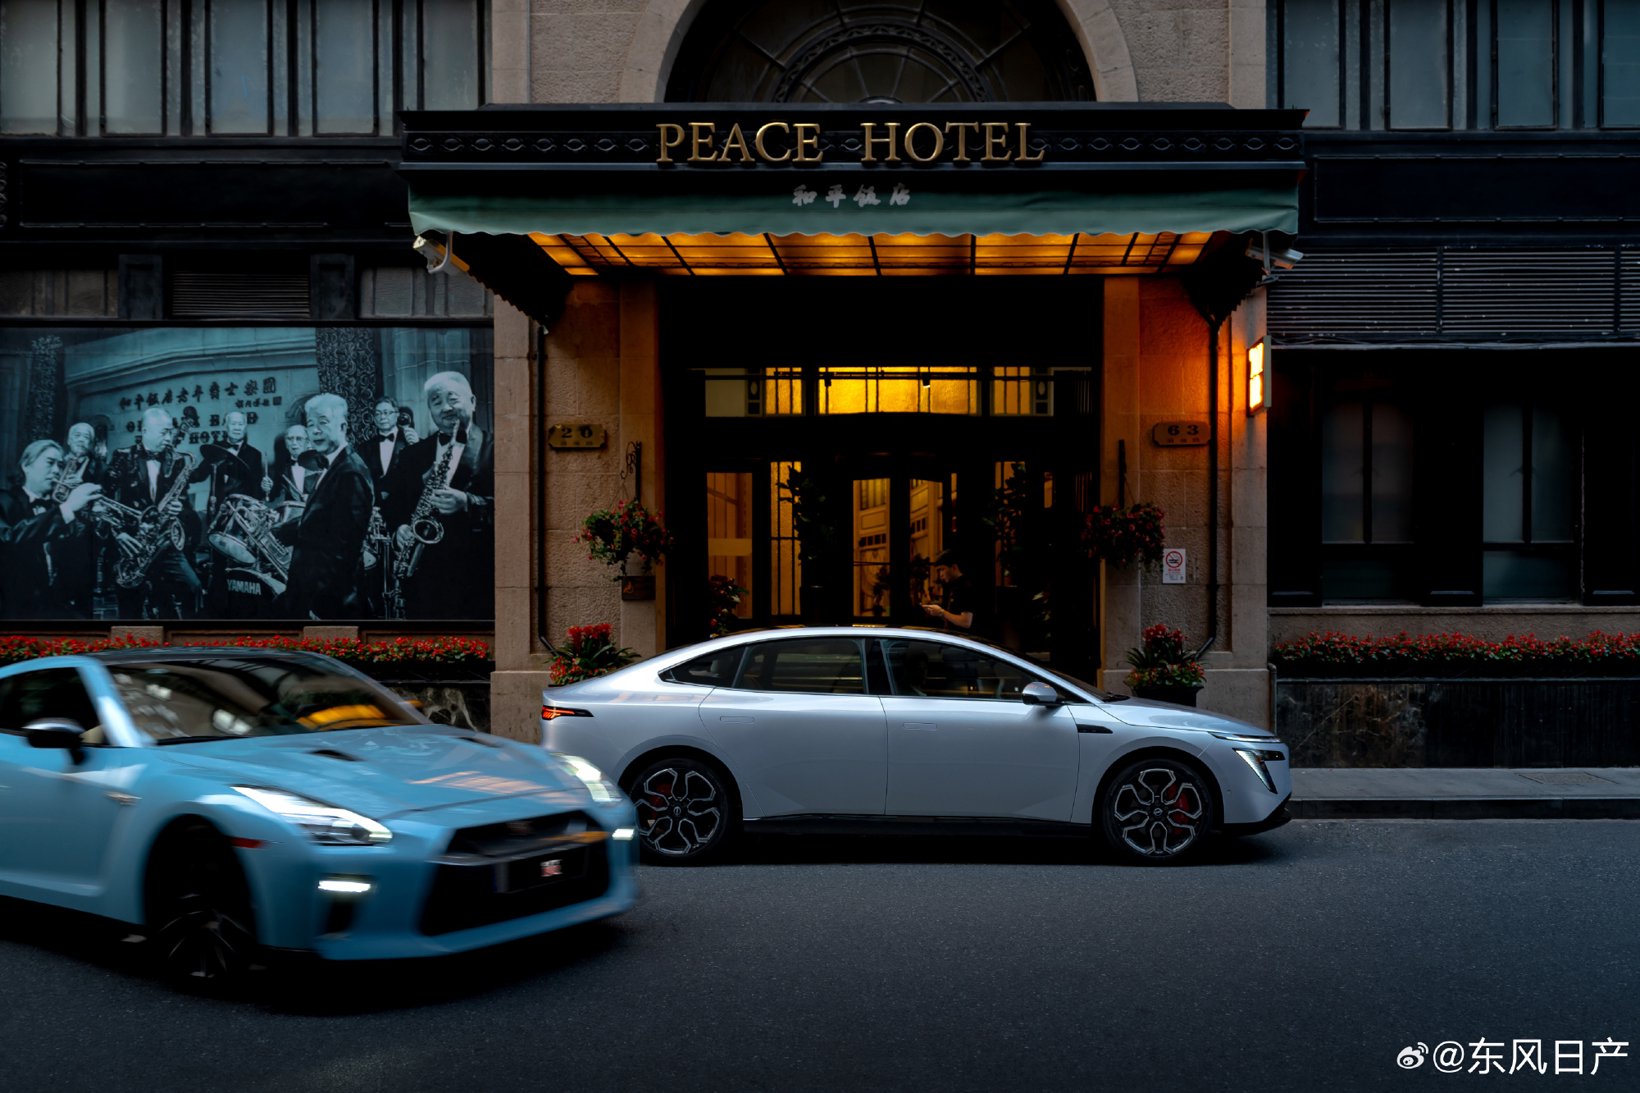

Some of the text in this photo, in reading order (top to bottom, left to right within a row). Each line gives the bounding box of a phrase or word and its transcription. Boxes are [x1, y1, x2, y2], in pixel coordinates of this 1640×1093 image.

[655, 121, 1045, 163] PEACE HOTEL
[1167, 424, 1200, 436] 63
[226, 579, 261, 595] YAMAHA
